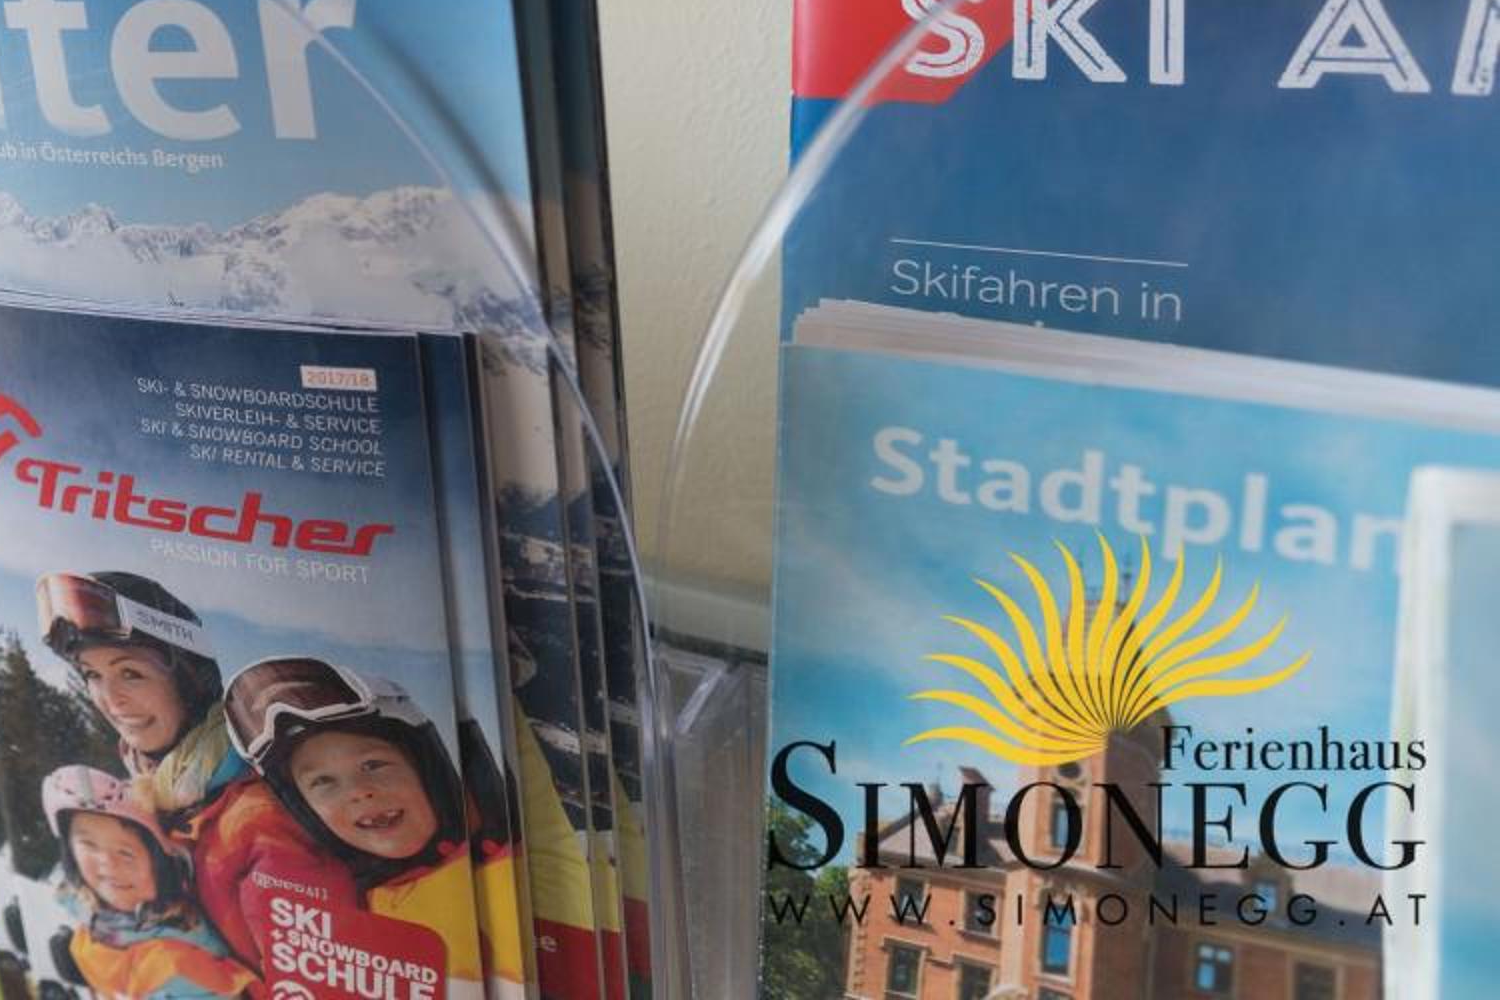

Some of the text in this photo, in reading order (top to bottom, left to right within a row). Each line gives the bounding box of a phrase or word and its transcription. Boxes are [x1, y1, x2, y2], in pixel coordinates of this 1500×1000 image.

[153, 149, 224, 173] Bergen
[890, 258, 1182, 322] Skifahren in
[136, 377, 381, 414] SKI- & SNOWBOARDSCHULE
[140, 417, 384, 457] SKI & SNOWBOARD SCHOOL
[175, 401, 383, 436] SKIVERLEIH- & SERVICE
[189, 442, 388, 479] SKI RENTAL & SERVICE
[14, 457, 396, 557] Tritscher
[870, 424, 1406, 582] Stadtplan
[149, 538, 371, 585] PASSION FOR SPORT
[269, 896, 332, 940] SKI
[287, 929, 439, 985] SNOWBOARD
